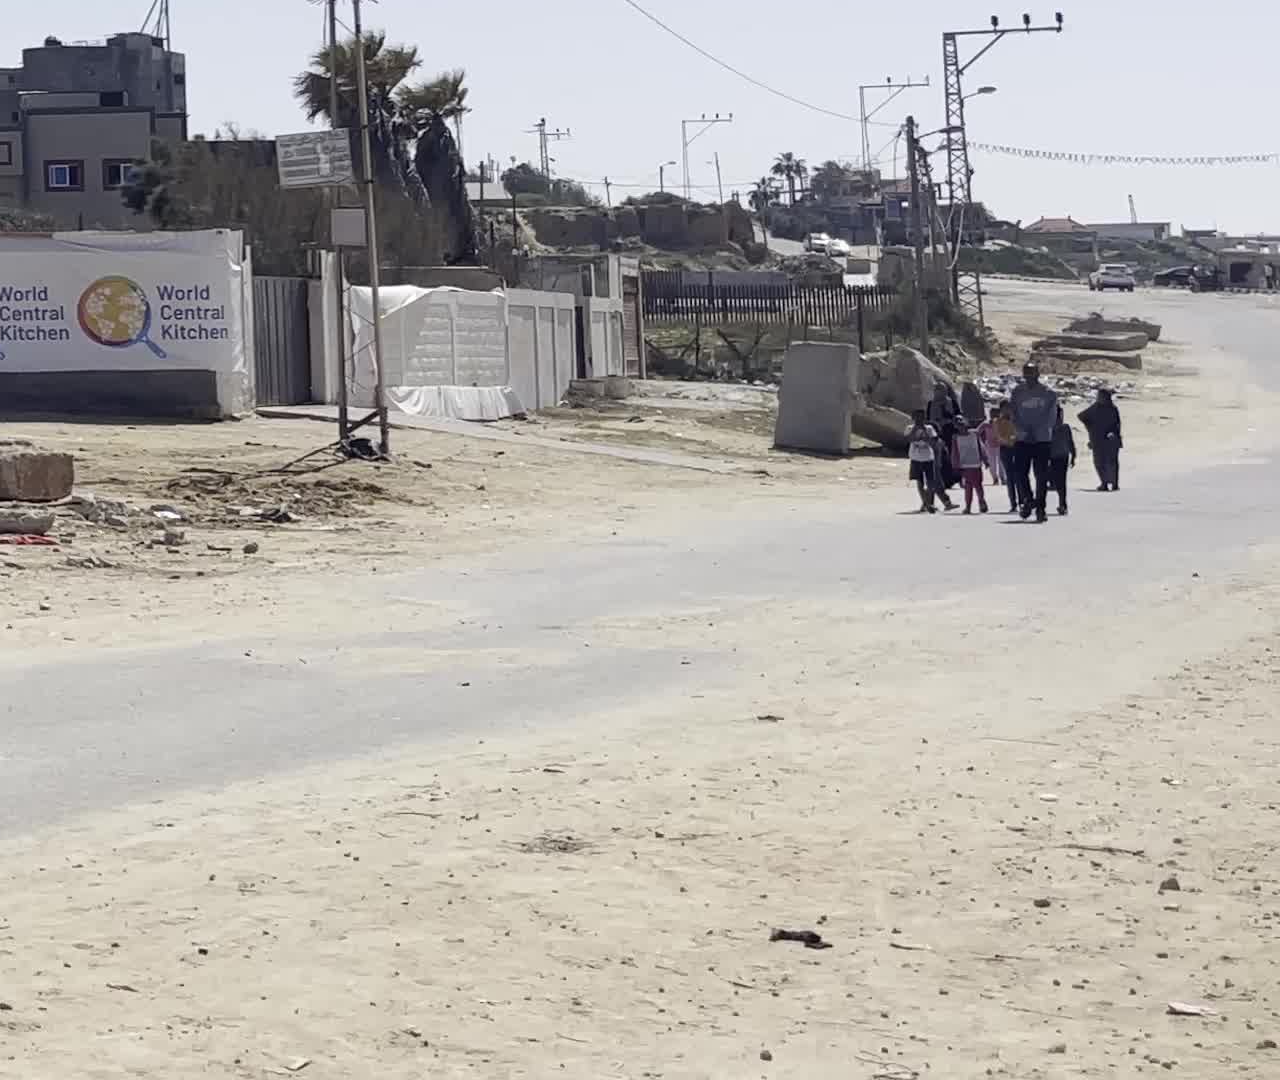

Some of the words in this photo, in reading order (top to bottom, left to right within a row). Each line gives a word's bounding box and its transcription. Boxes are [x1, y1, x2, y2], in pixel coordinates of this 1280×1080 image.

[156, 285, 210, 301] World
[0, 306, 64, 322] Central
[160, 305, 225, 321] Central
[0, 325, 69, 342] Kitchen
[160, 325, 229, 340] Kitchen
